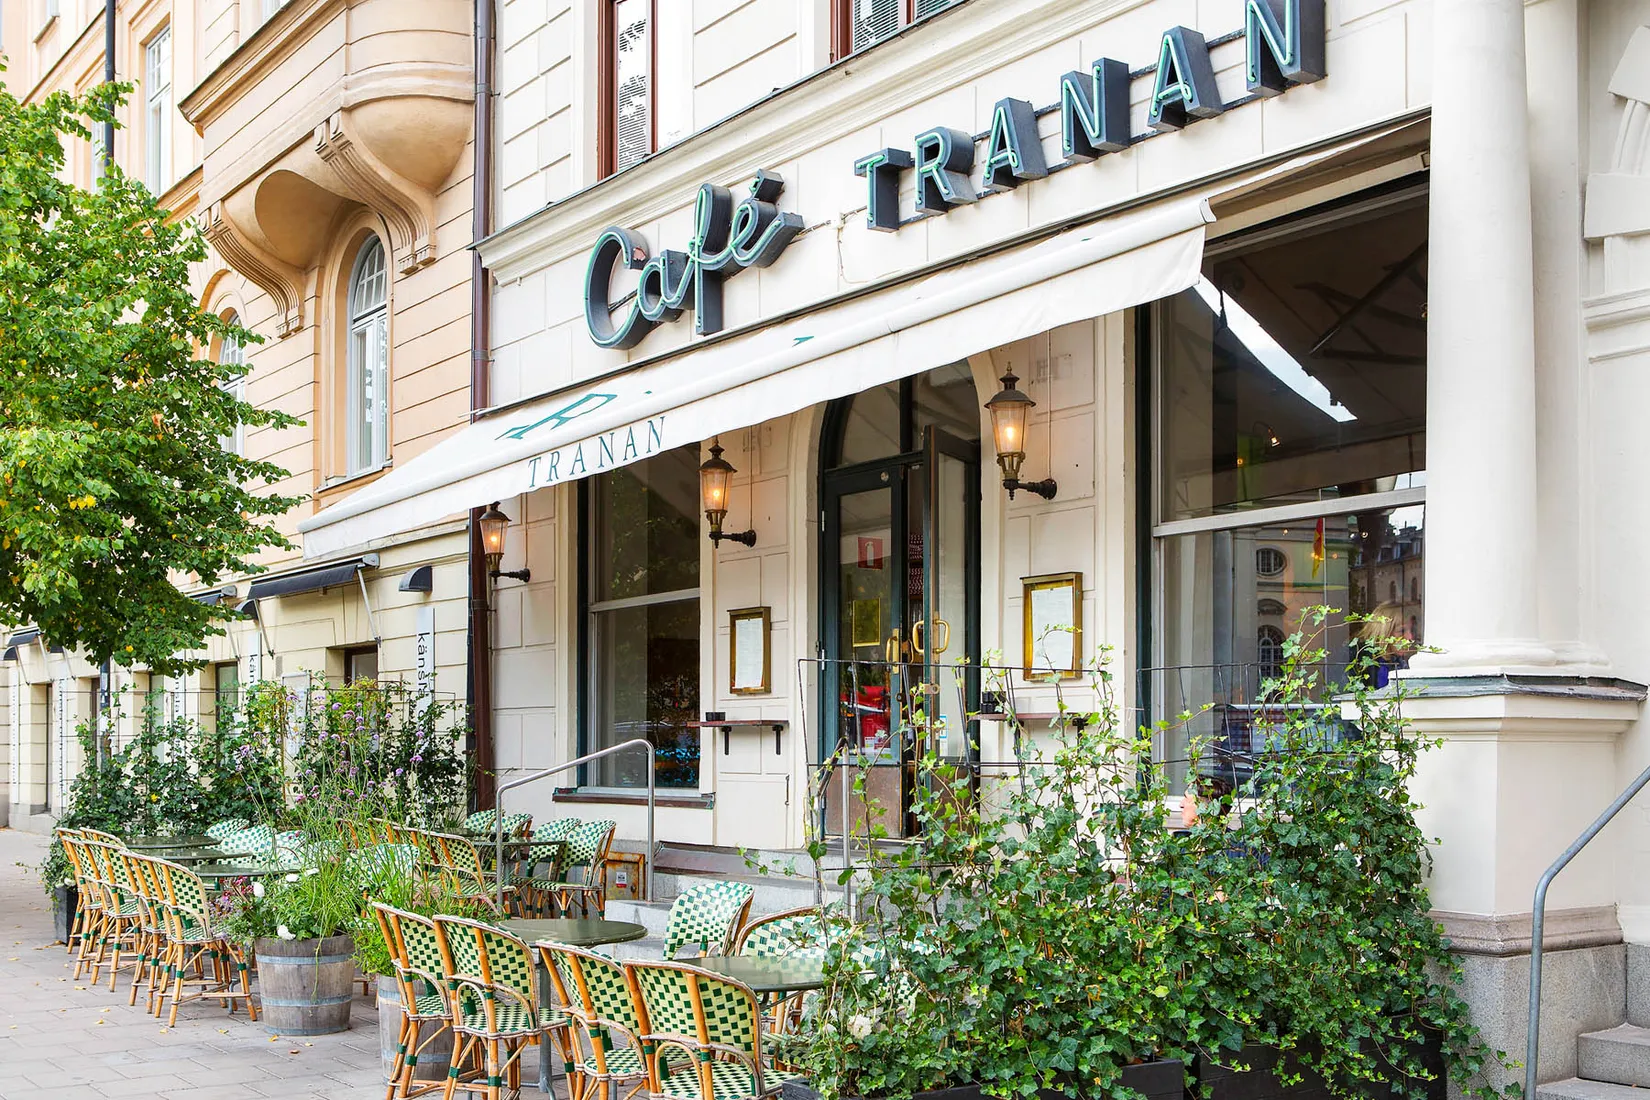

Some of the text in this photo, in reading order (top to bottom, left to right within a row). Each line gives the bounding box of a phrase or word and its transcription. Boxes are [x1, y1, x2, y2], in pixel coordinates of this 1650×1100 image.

[584, 0, 1326, 349] Café TRANAN
[528, 416, 665, 488] TRANAN
